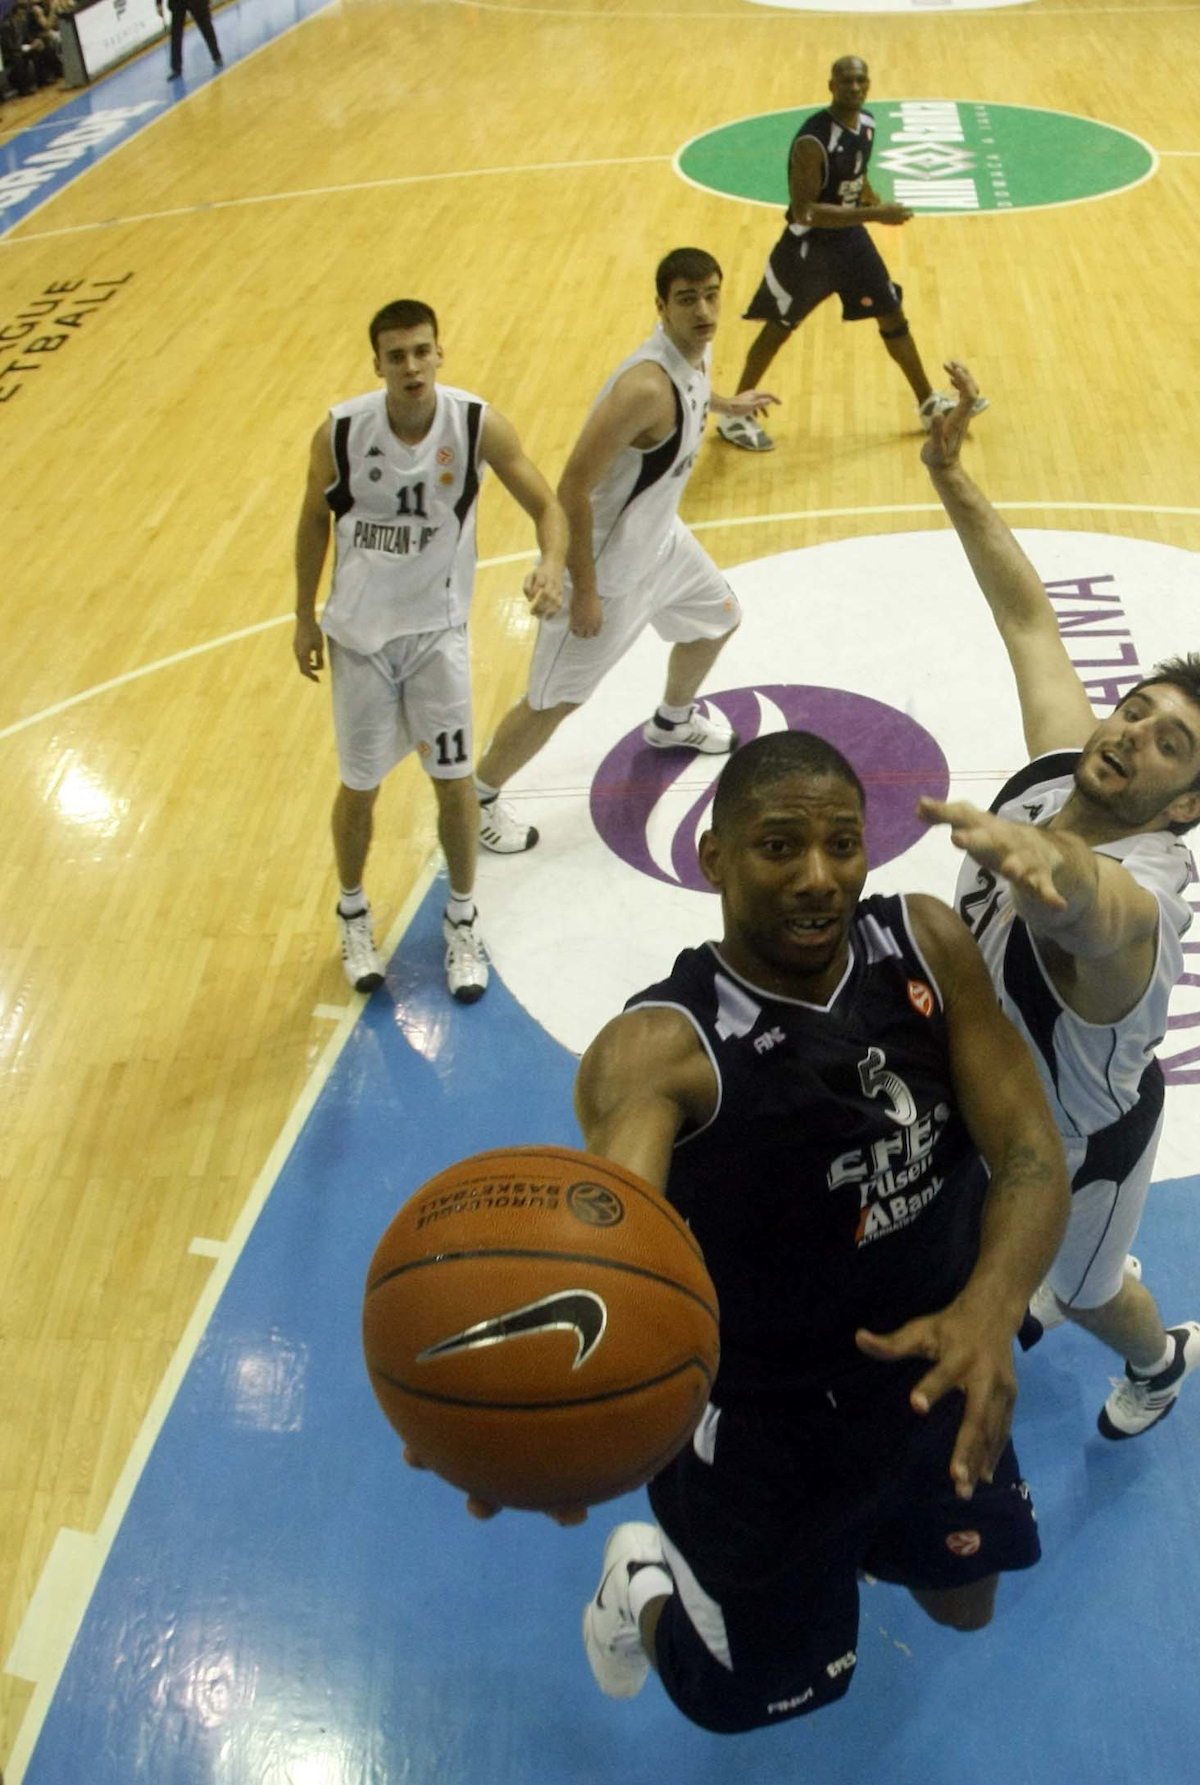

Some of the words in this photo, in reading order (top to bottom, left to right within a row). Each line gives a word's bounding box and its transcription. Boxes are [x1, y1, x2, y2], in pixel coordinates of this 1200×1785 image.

[0, 279, 86, 353] GUE
[396, 482, 427, 520] 11
[354, 520, 411, 554] PARTIZAN
[435, 728, 468, 766] 11
[857, 1046, 918, 1127] 5
[826, 1110, 941, 1191] EFE
